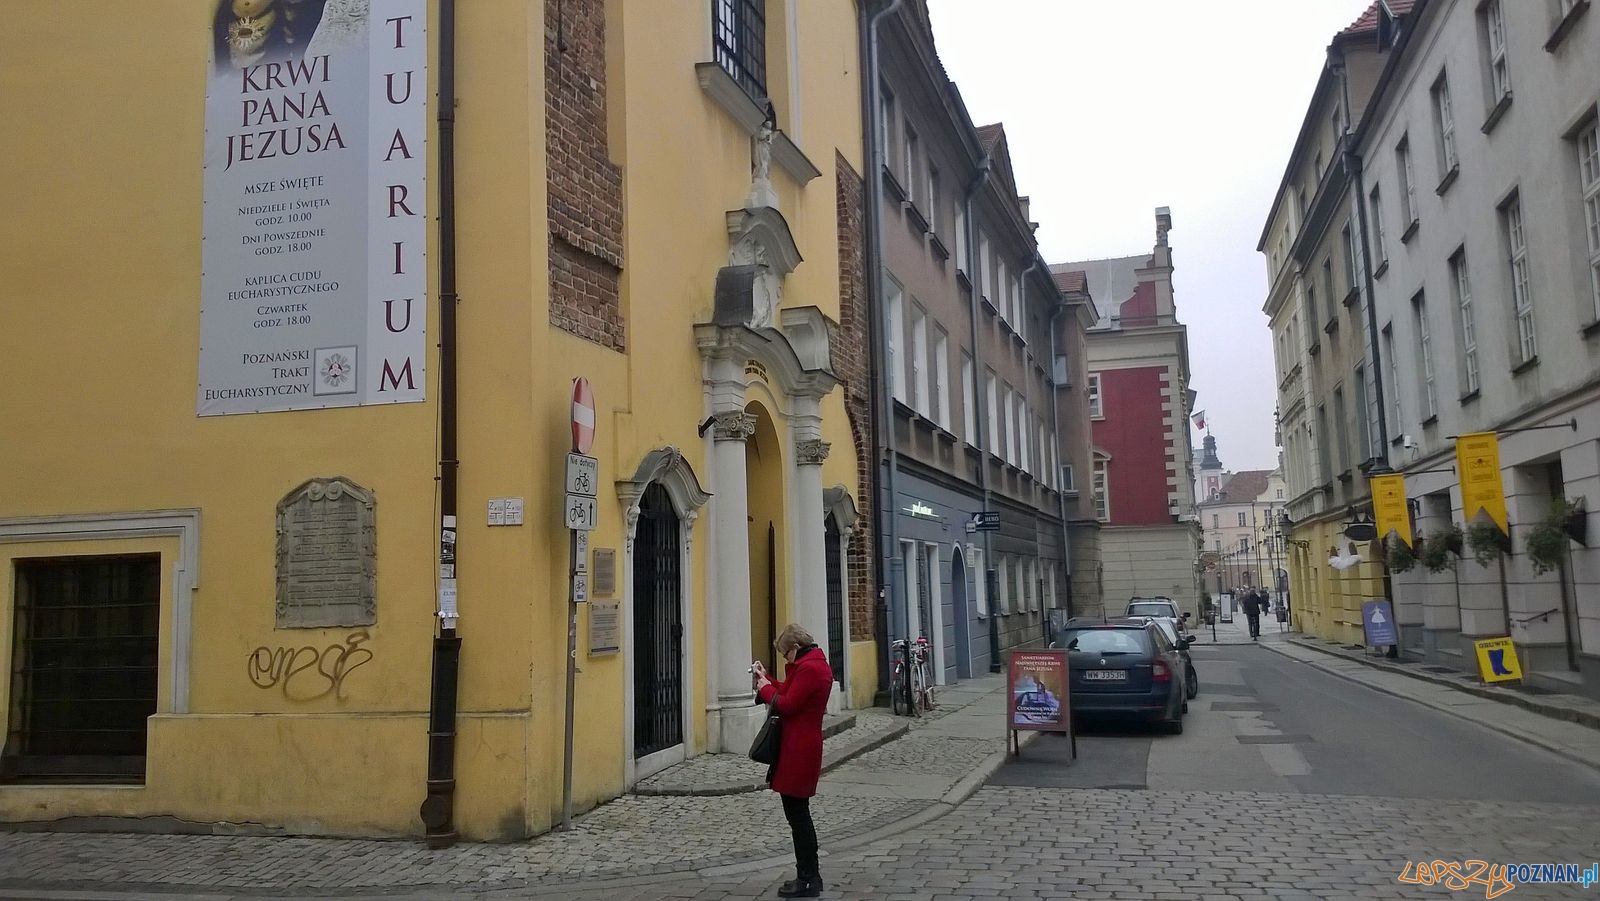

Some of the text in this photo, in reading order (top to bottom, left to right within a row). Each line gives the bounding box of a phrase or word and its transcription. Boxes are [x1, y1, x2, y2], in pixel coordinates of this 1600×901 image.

[241, 54, 332, 94] KRWI
[241, 89, 332, 127] PANA
[224, 122, 348, 172] JEZUSA
[244, 175, 324, 194] MSZE ŚWIĘTE
[288, 212, 312, 223] 10.00
[242, 228, 326, 245] DNI POWSZEDNIE
[288, 242, 312, 252] 18.00
[245, 270, 322, 286] KAPLICA CUDU
[228, 281, 339, 301] EUCHARYSTYCZNEGO
[257, 303, 308, 315] CZWARTEK
[287, 315, 311, 325] 18.00
[243, 349, 310, 364] POZNAŃSKI
[272, 367, 310, 379] TRAKT
[205, 383, 310, 400] EUCHARYSTYCZNY
